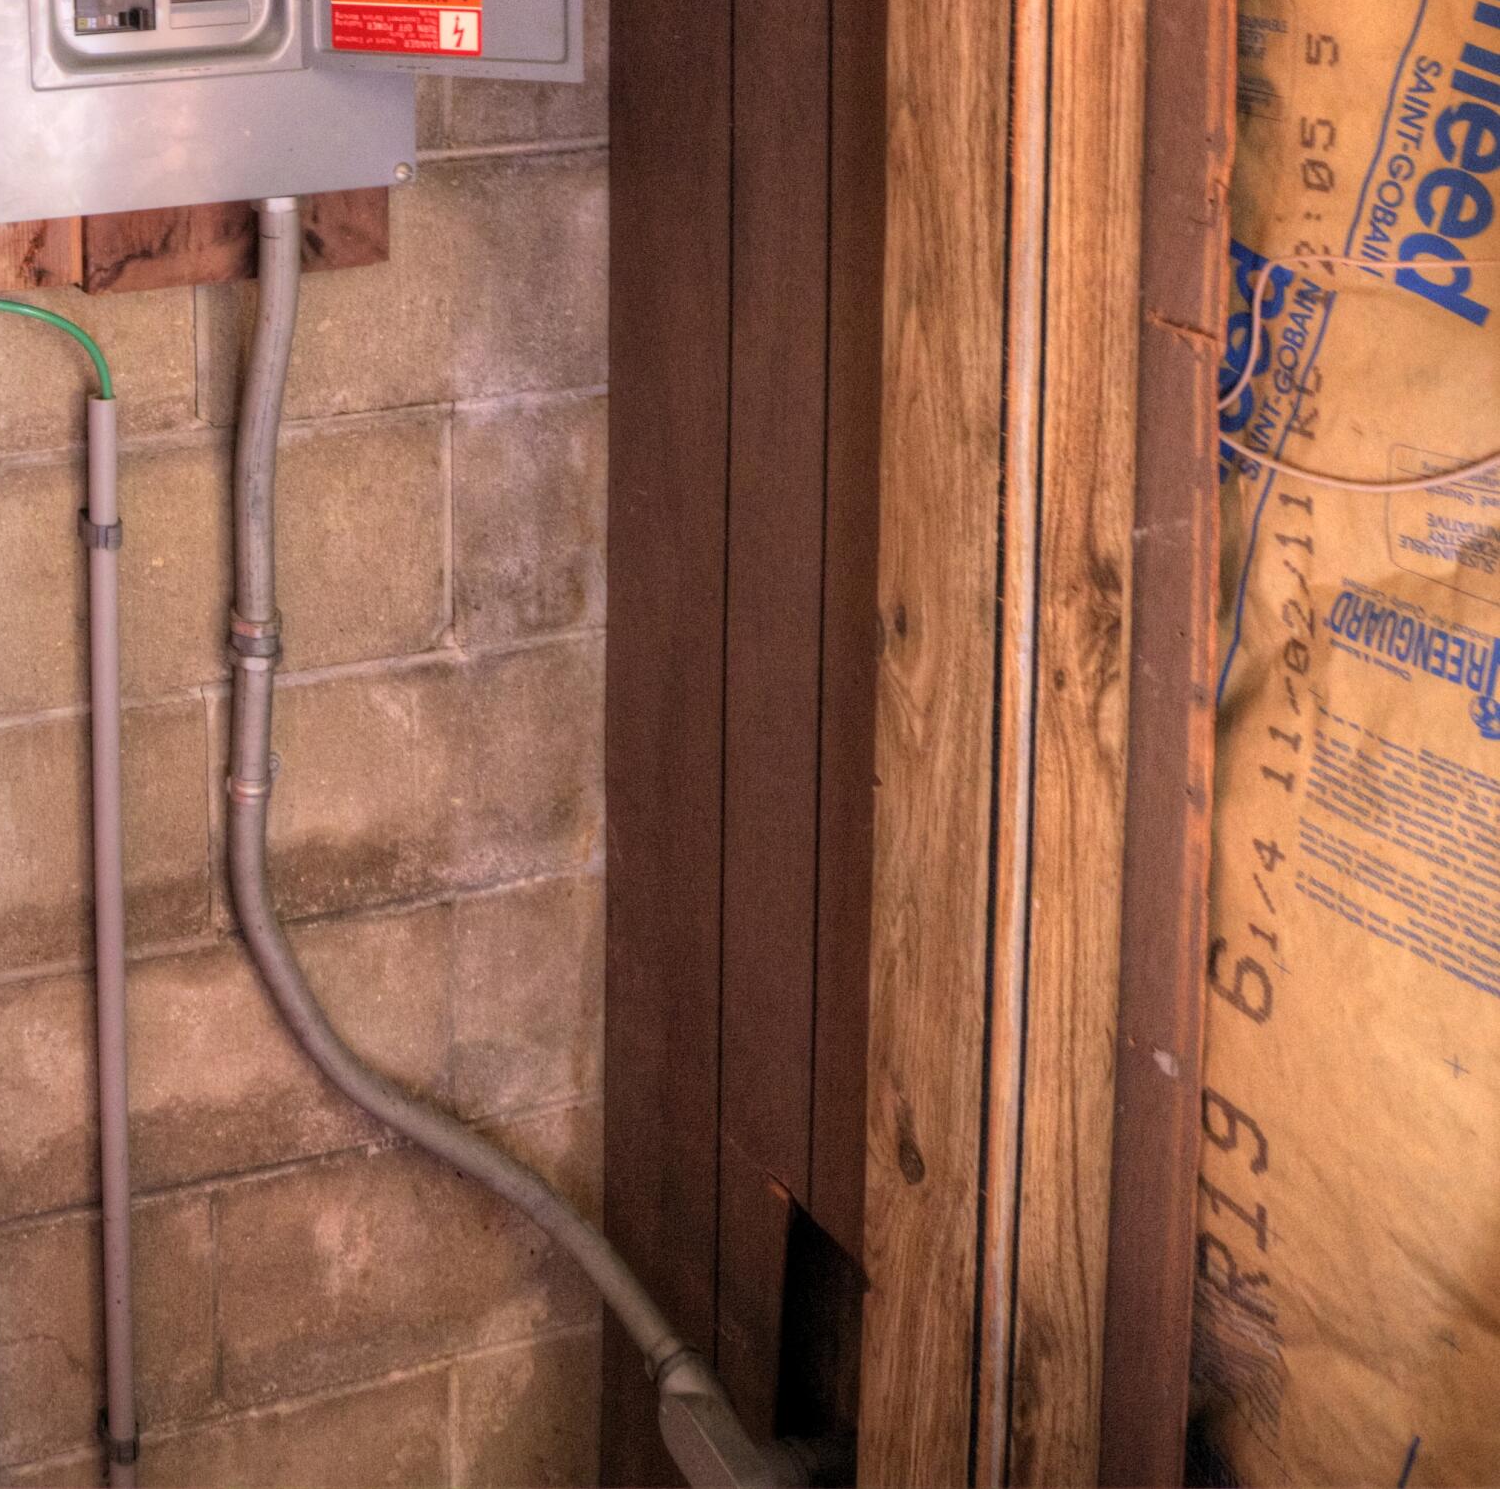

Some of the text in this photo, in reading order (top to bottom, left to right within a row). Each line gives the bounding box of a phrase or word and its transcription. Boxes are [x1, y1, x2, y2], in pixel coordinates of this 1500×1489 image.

[1304, 32, 1340, 67] 5
[1359, 55, 1443, 278] SAINT-GOBAIN
[1237, 277, 1325, 482] SAINT-GOBAIN
